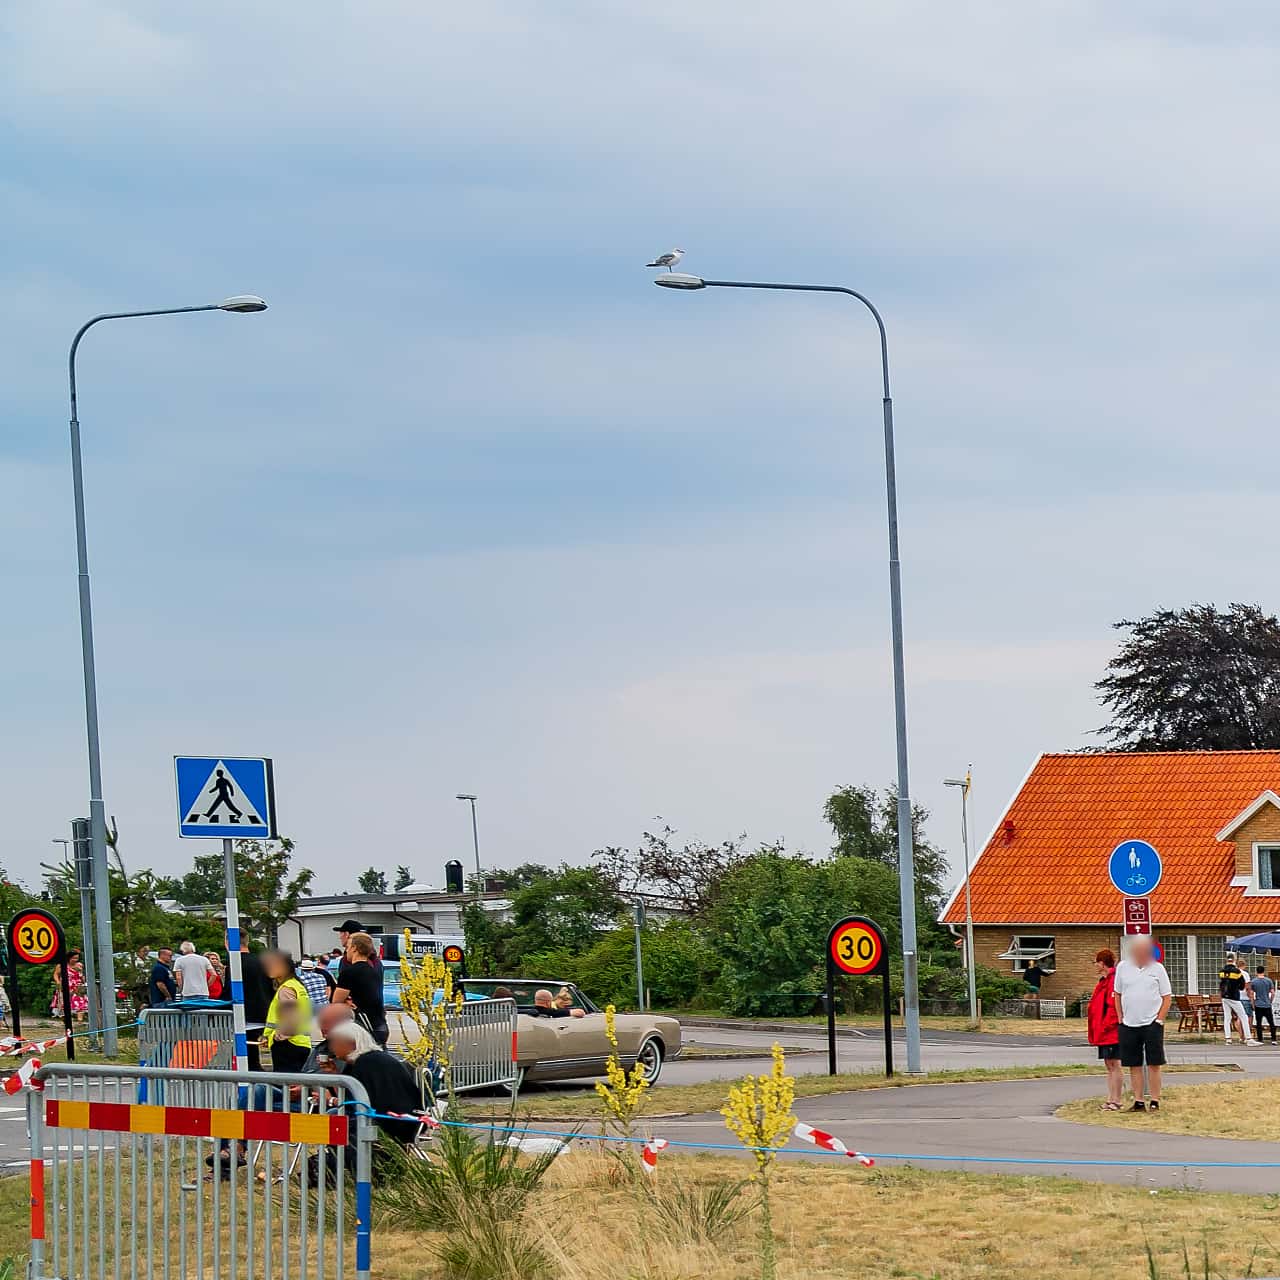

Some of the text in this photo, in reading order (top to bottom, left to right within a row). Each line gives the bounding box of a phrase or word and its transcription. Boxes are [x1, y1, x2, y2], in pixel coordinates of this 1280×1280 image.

[21, 926, 52, 950] 30
[840, 935, 873, 960] 30
[448, 951, 459, 959] 30
